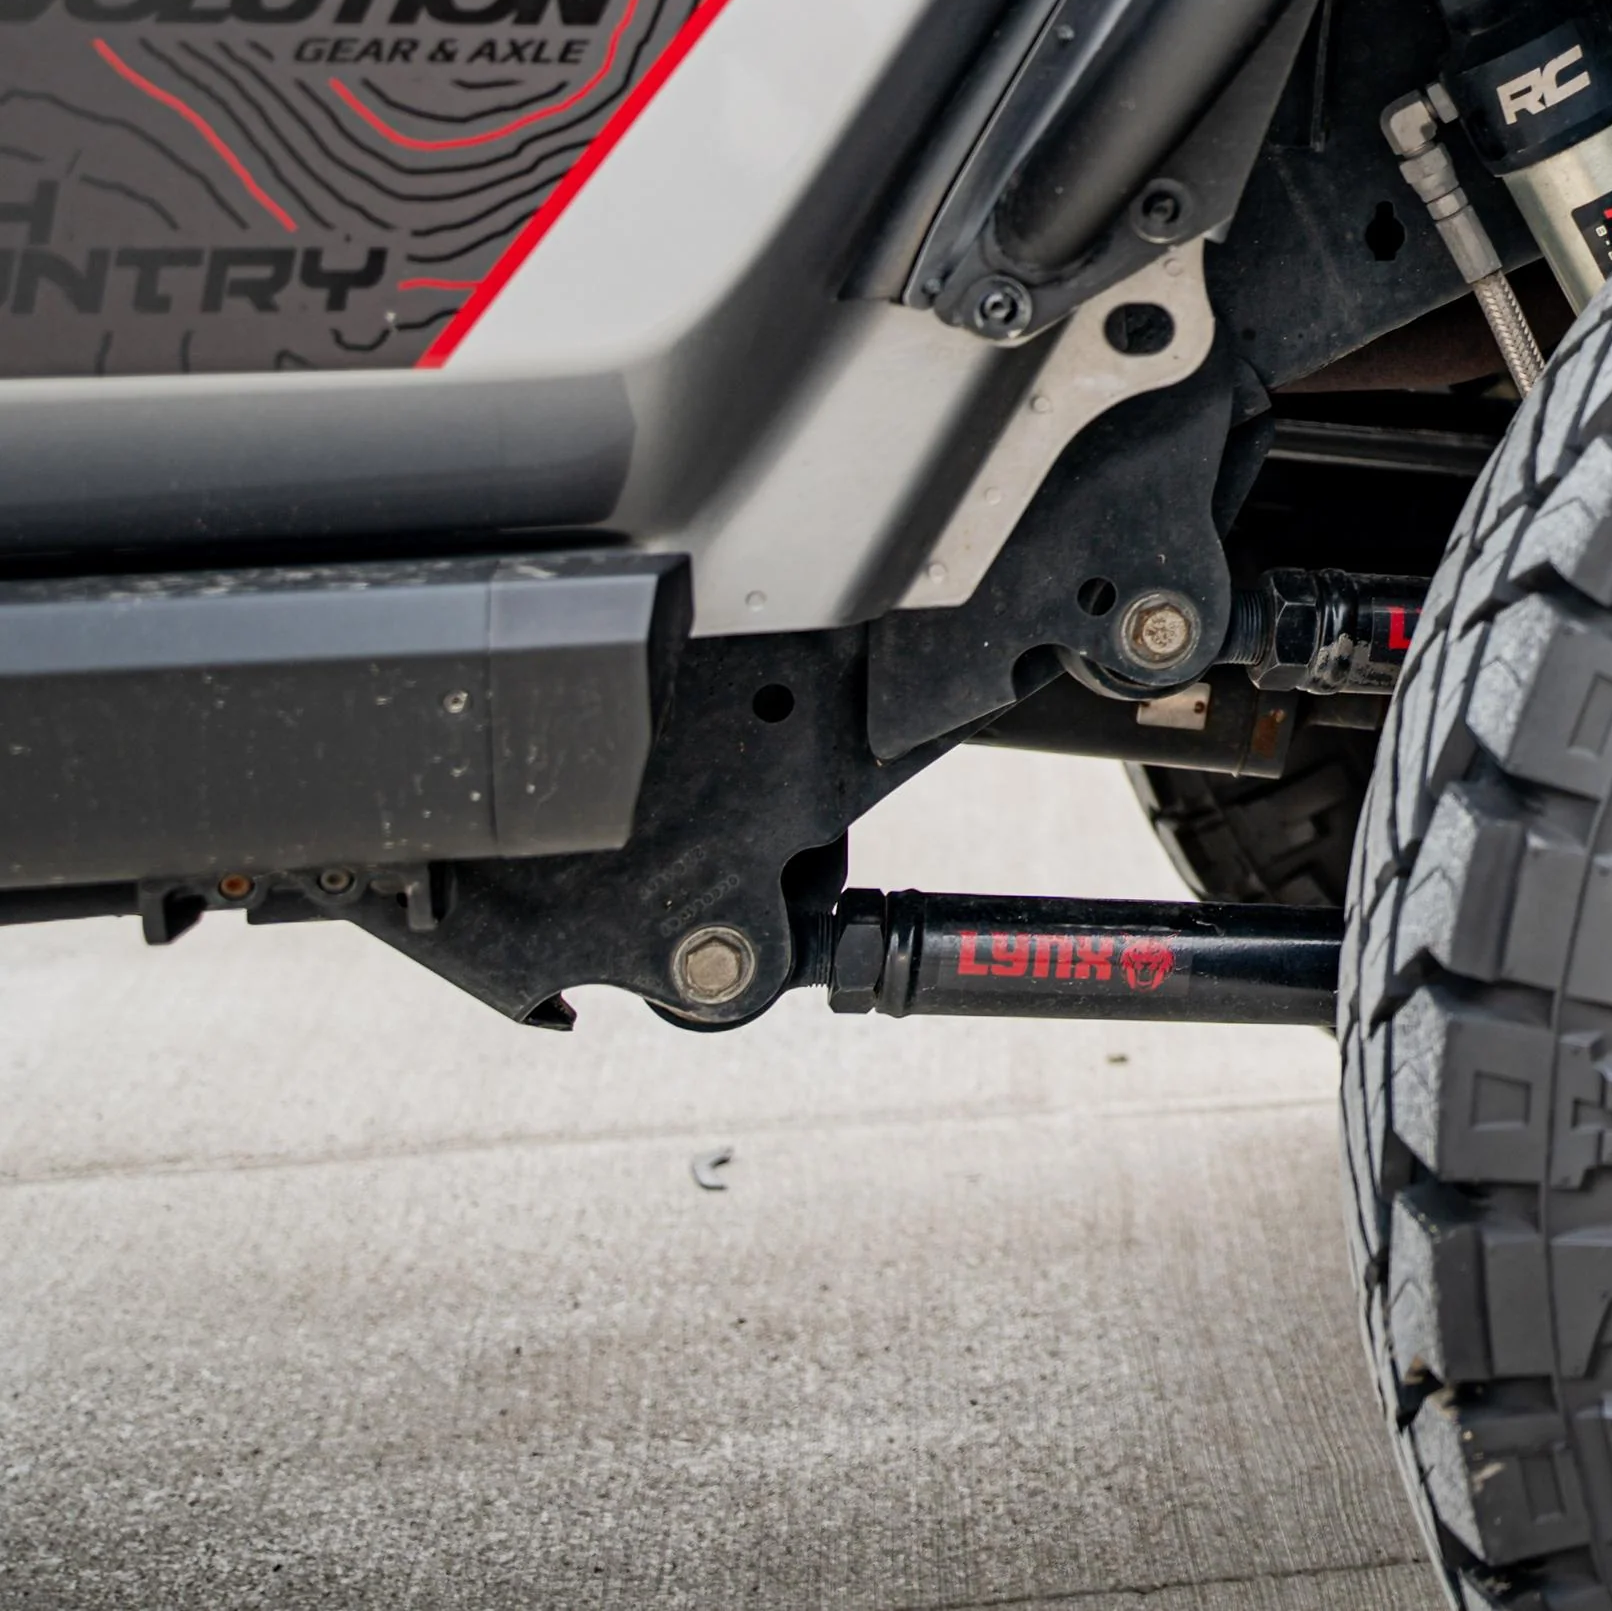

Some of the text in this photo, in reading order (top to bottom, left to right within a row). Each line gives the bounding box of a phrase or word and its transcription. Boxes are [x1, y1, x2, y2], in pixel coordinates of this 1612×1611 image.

[294, 37, 591, 67] GEAR & AXLE
[1496, 43, 1592, 125] RC
